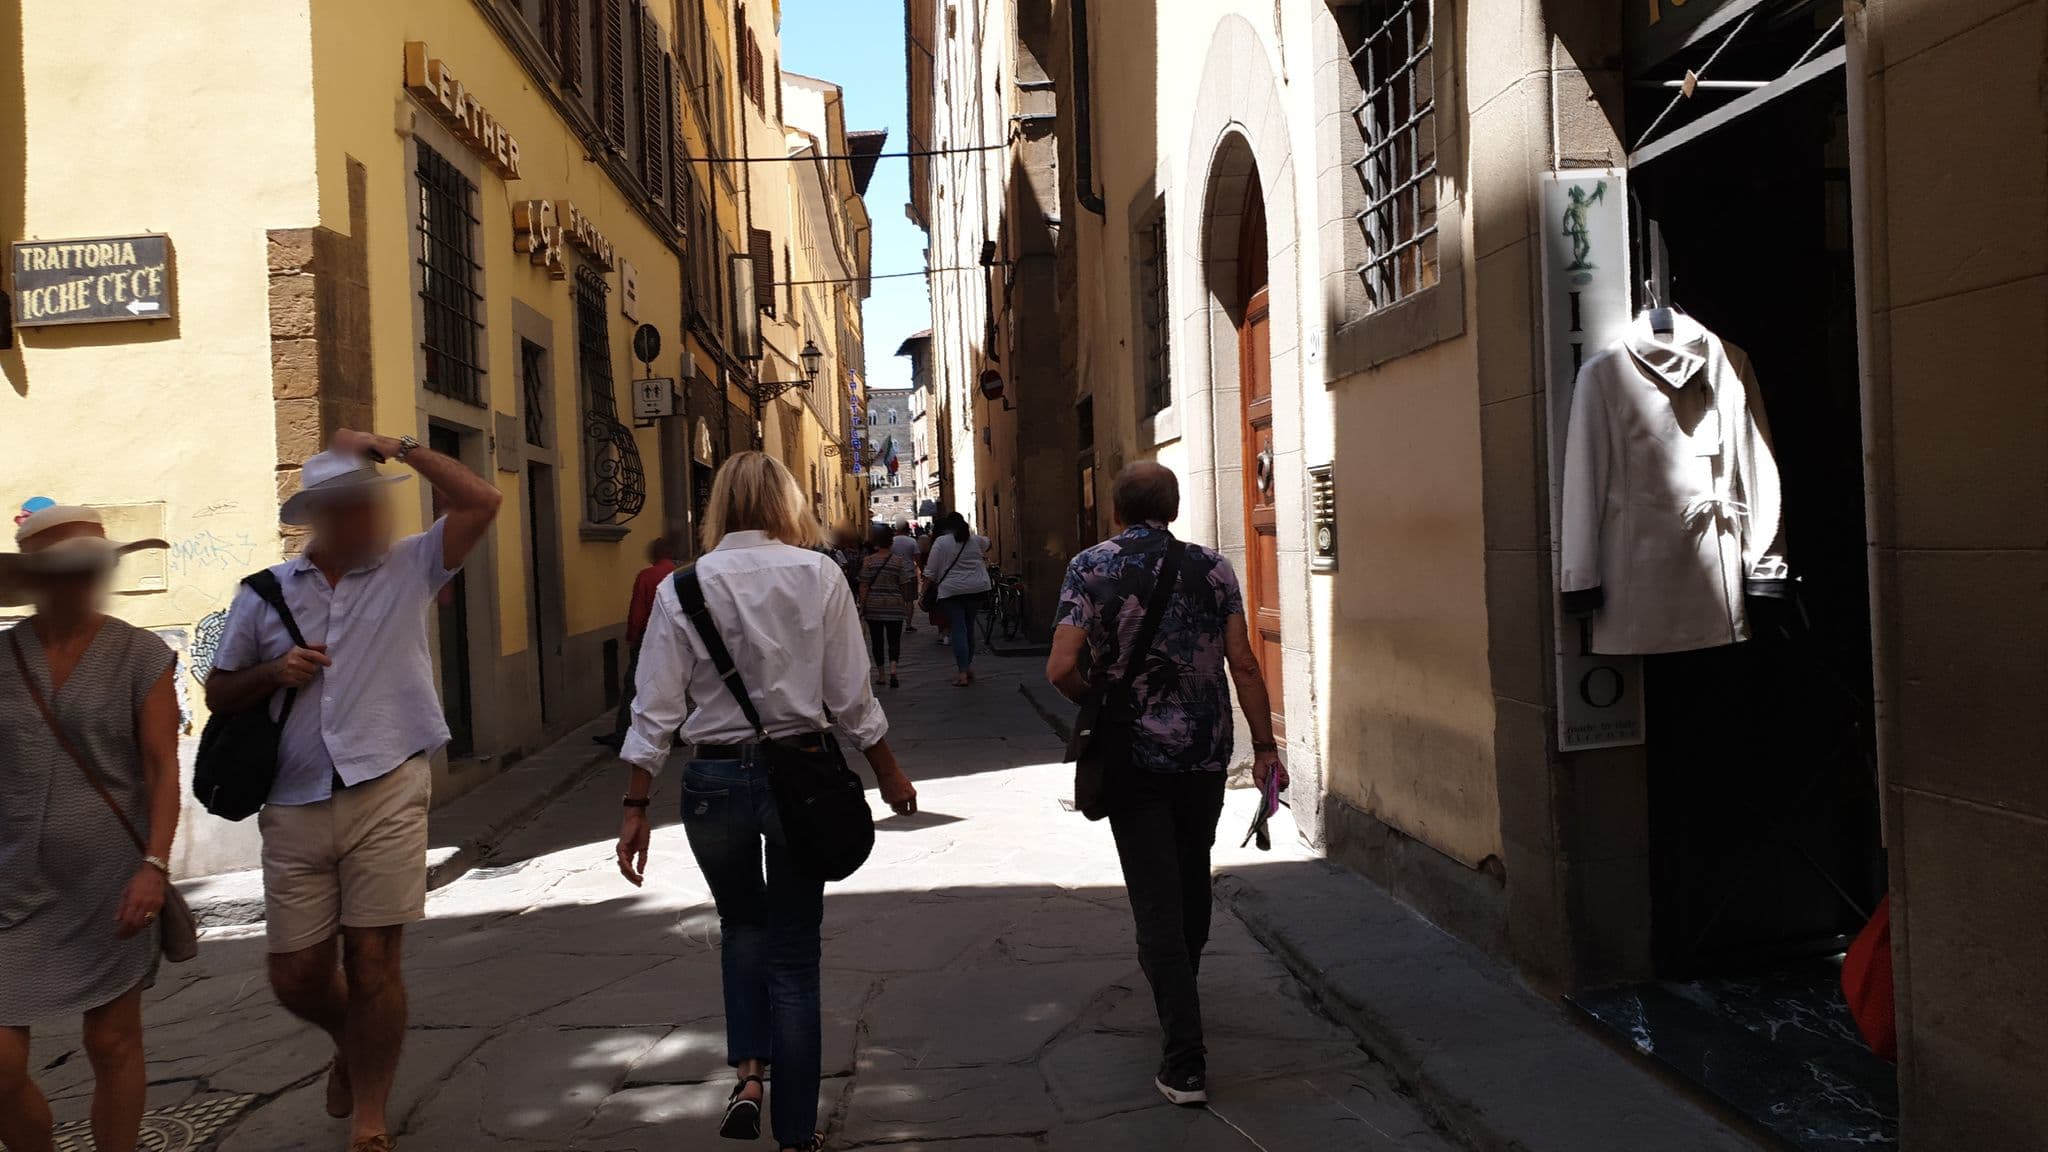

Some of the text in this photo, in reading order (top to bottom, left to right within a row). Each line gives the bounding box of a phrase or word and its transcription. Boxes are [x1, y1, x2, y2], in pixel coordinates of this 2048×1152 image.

[420, 41, 521, 176] LEATHER
[20, 242, 137, 271] TRATTORIA
[847, 368, 862, 474] TRATTORIA
